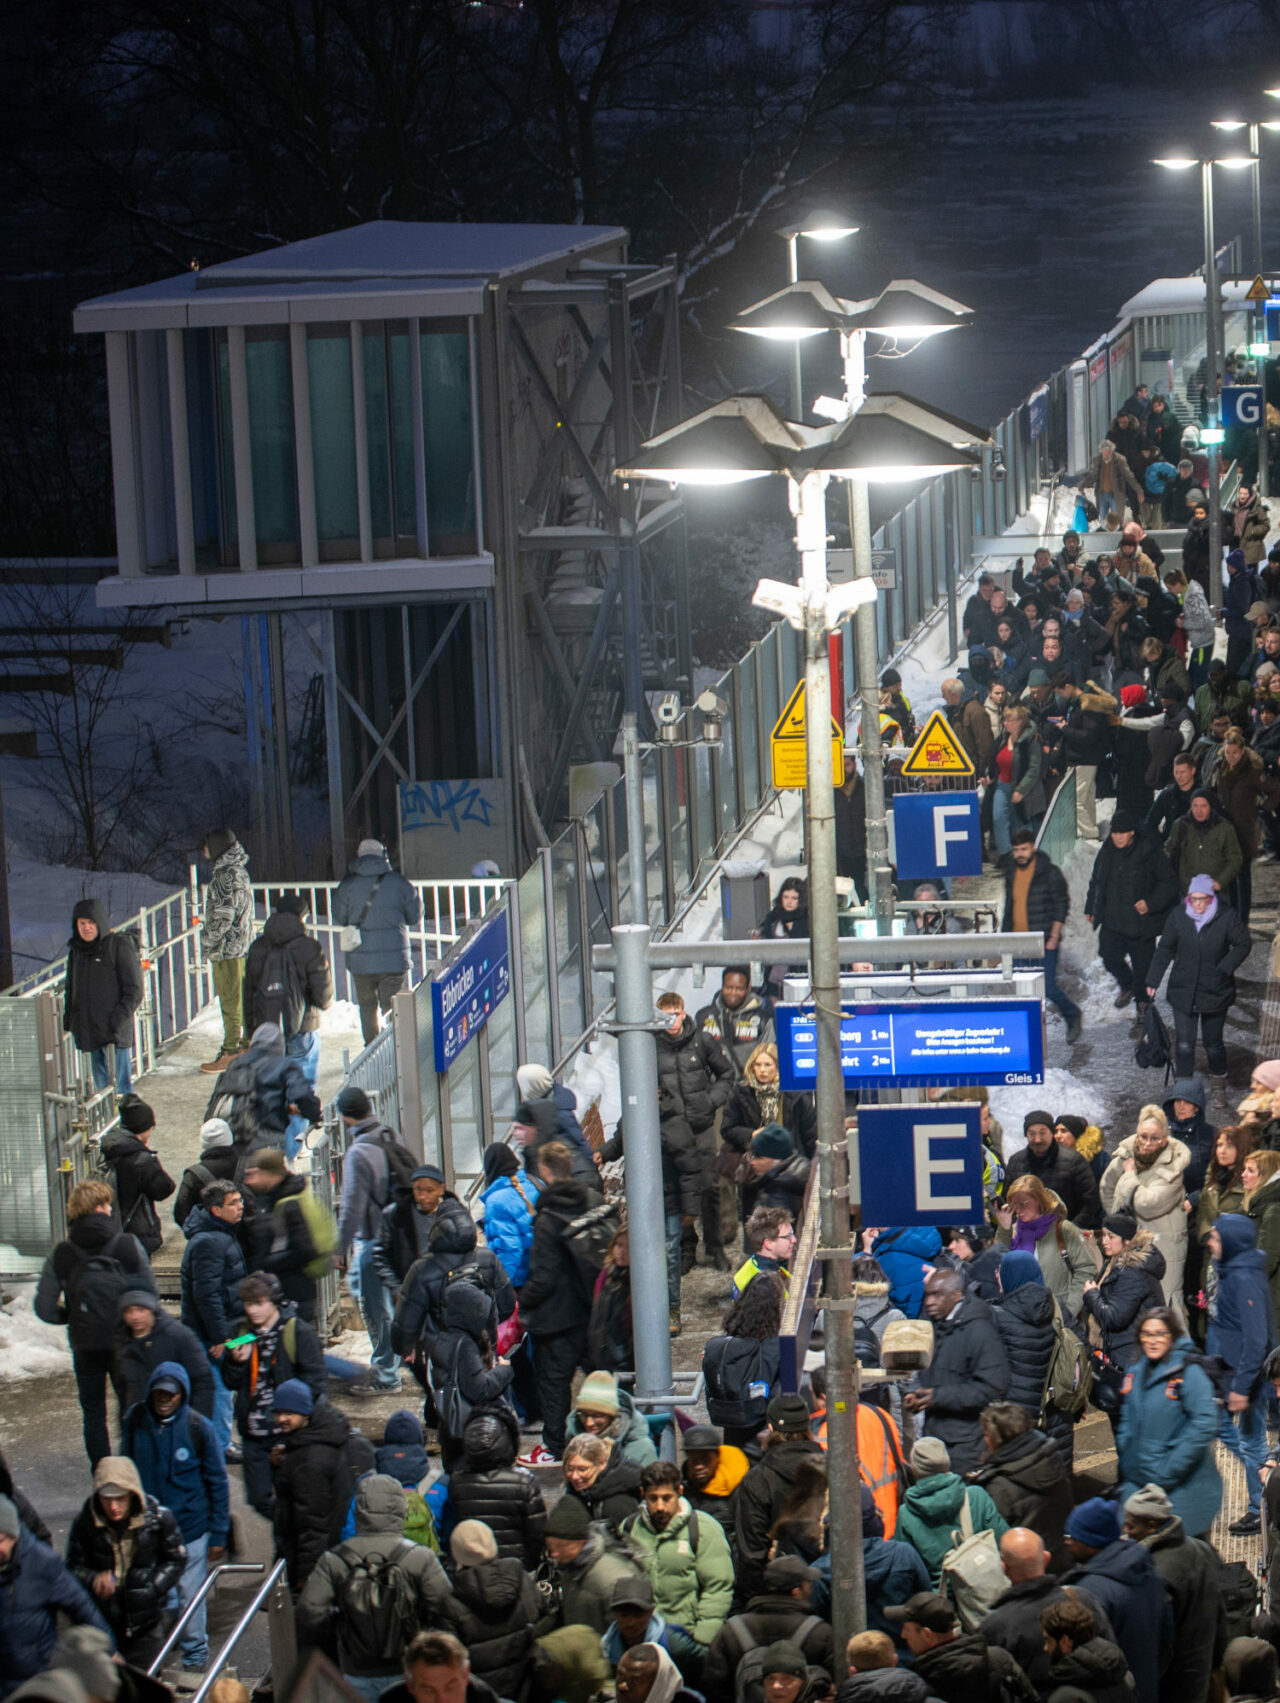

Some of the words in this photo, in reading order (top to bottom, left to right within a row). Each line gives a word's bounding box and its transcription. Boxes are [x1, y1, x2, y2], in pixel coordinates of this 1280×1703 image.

[1236, 392, 1259, 423] G
[872, 570, 888, 578] nfo
[933, 804, 971, 867] F
[442, 965, 475, 1019] Elbbrücken
[871, 1029, 877, 1041] 1
[872, 1055, 880, 1067] 2
[1005, 1073, 1033, 1084] Gleis
[1035, 1073, 1042, 1084] 1
[913, 1123, 972, 1211] E
